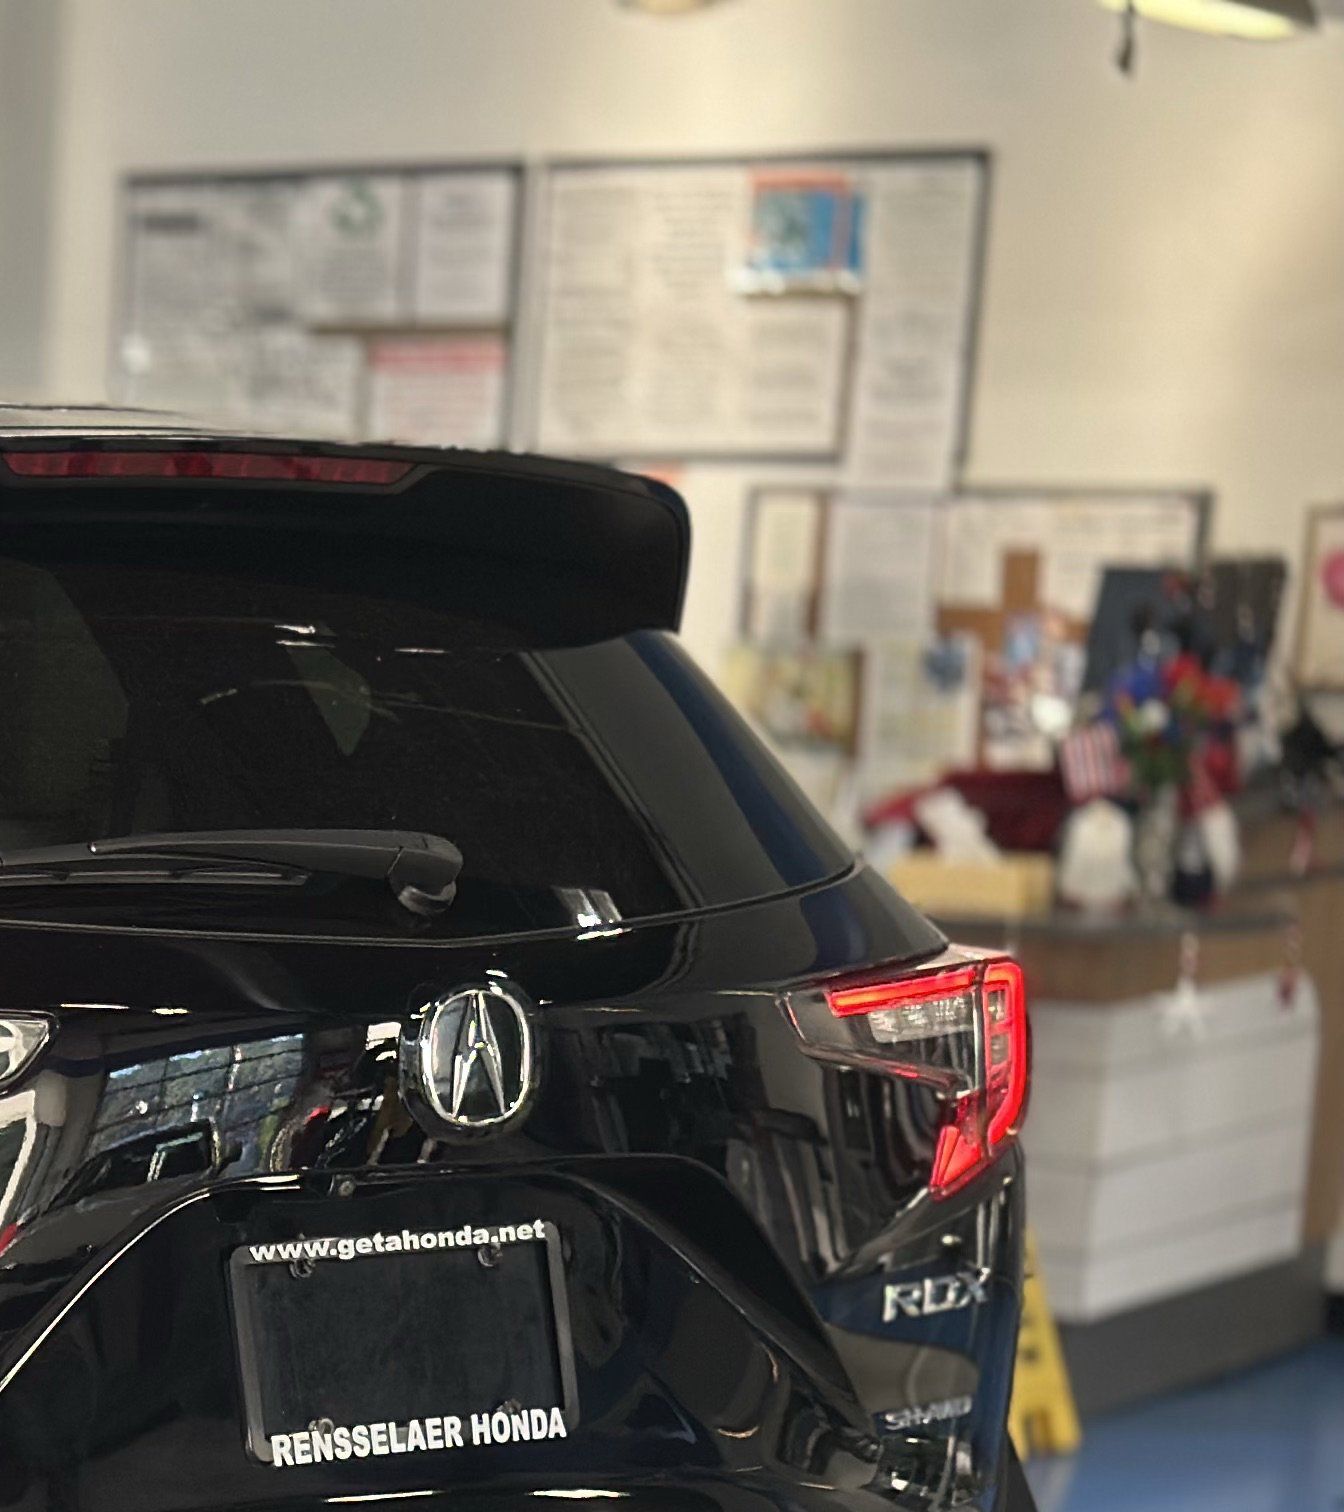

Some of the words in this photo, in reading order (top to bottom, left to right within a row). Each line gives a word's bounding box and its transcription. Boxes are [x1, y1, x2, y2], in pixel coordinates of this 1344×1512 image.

[248, 1218, 546, 1262] www.getahonda.net
[882, 1266, 992, 1324] RDX
[269, 1415, 464, 1467] RENSSELAER
[470, 1406, 568, 1446] HONDA
